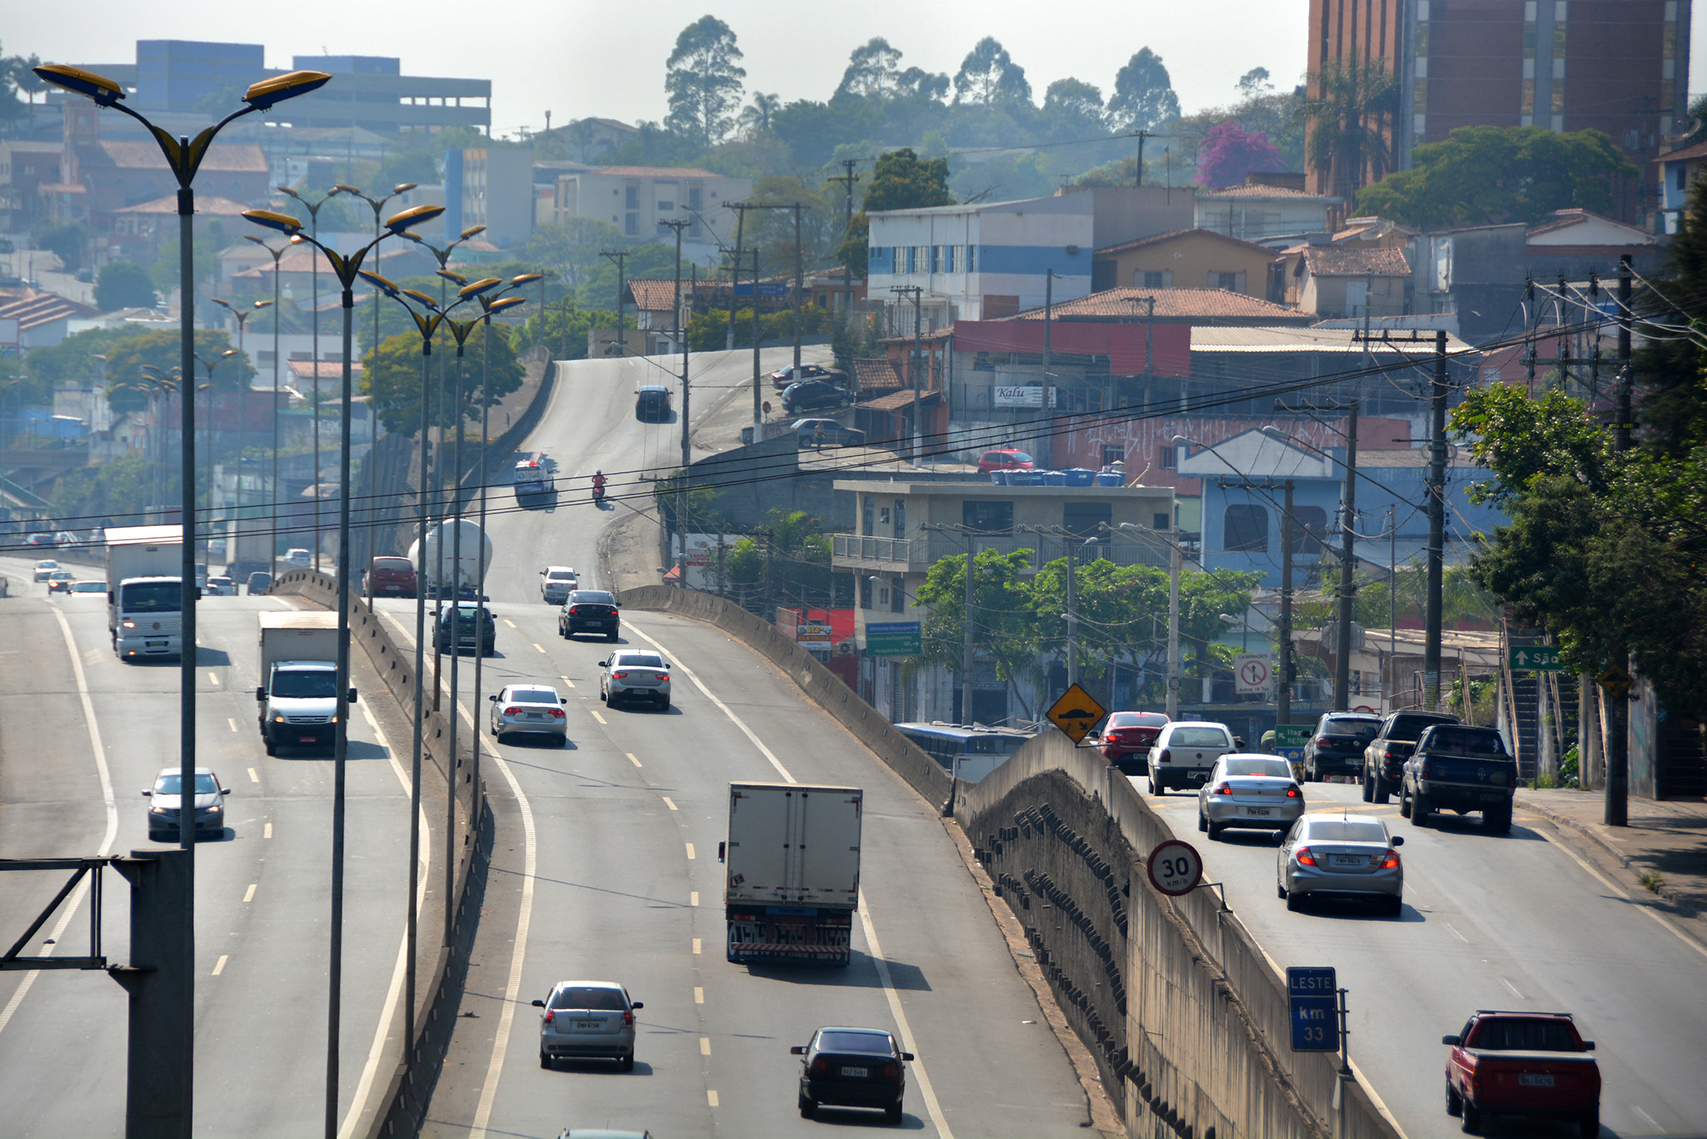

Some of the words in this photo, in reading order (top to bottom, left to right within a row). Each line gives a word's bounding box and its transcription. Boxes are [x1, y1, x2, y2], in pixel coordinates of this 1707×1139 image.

[997, 387, 1025, 400] Kalu
[1162, 857, 1189, 878] 30
[1167, 878, 1188, 886] km/h
[1290, 977, 1332, 989] LESTE
[1299, 1006, 1325, 1020] km
[1304, 1027, 1324, 1041] 33
